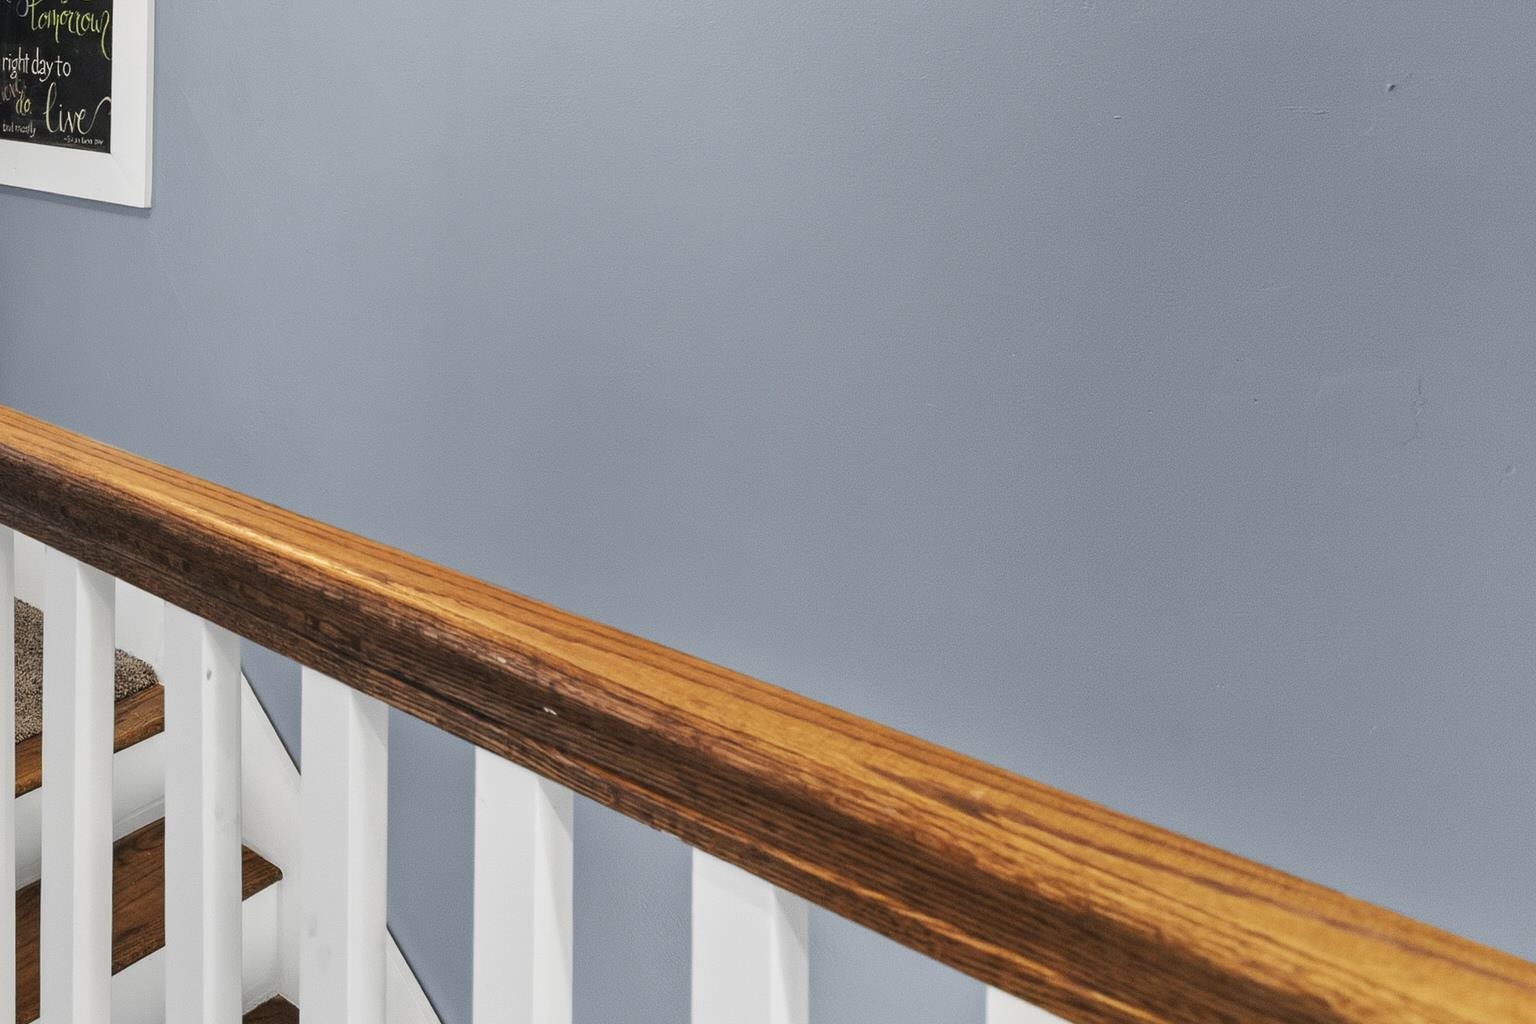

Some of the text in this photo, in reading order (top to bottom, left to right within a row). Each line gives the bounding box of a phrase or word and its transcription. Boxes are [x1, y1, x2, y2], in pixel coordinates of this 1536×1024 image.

[2, 46, 30, 80] right
[31, 45, 53, 83] day
[56, 55, 72, 78] to
